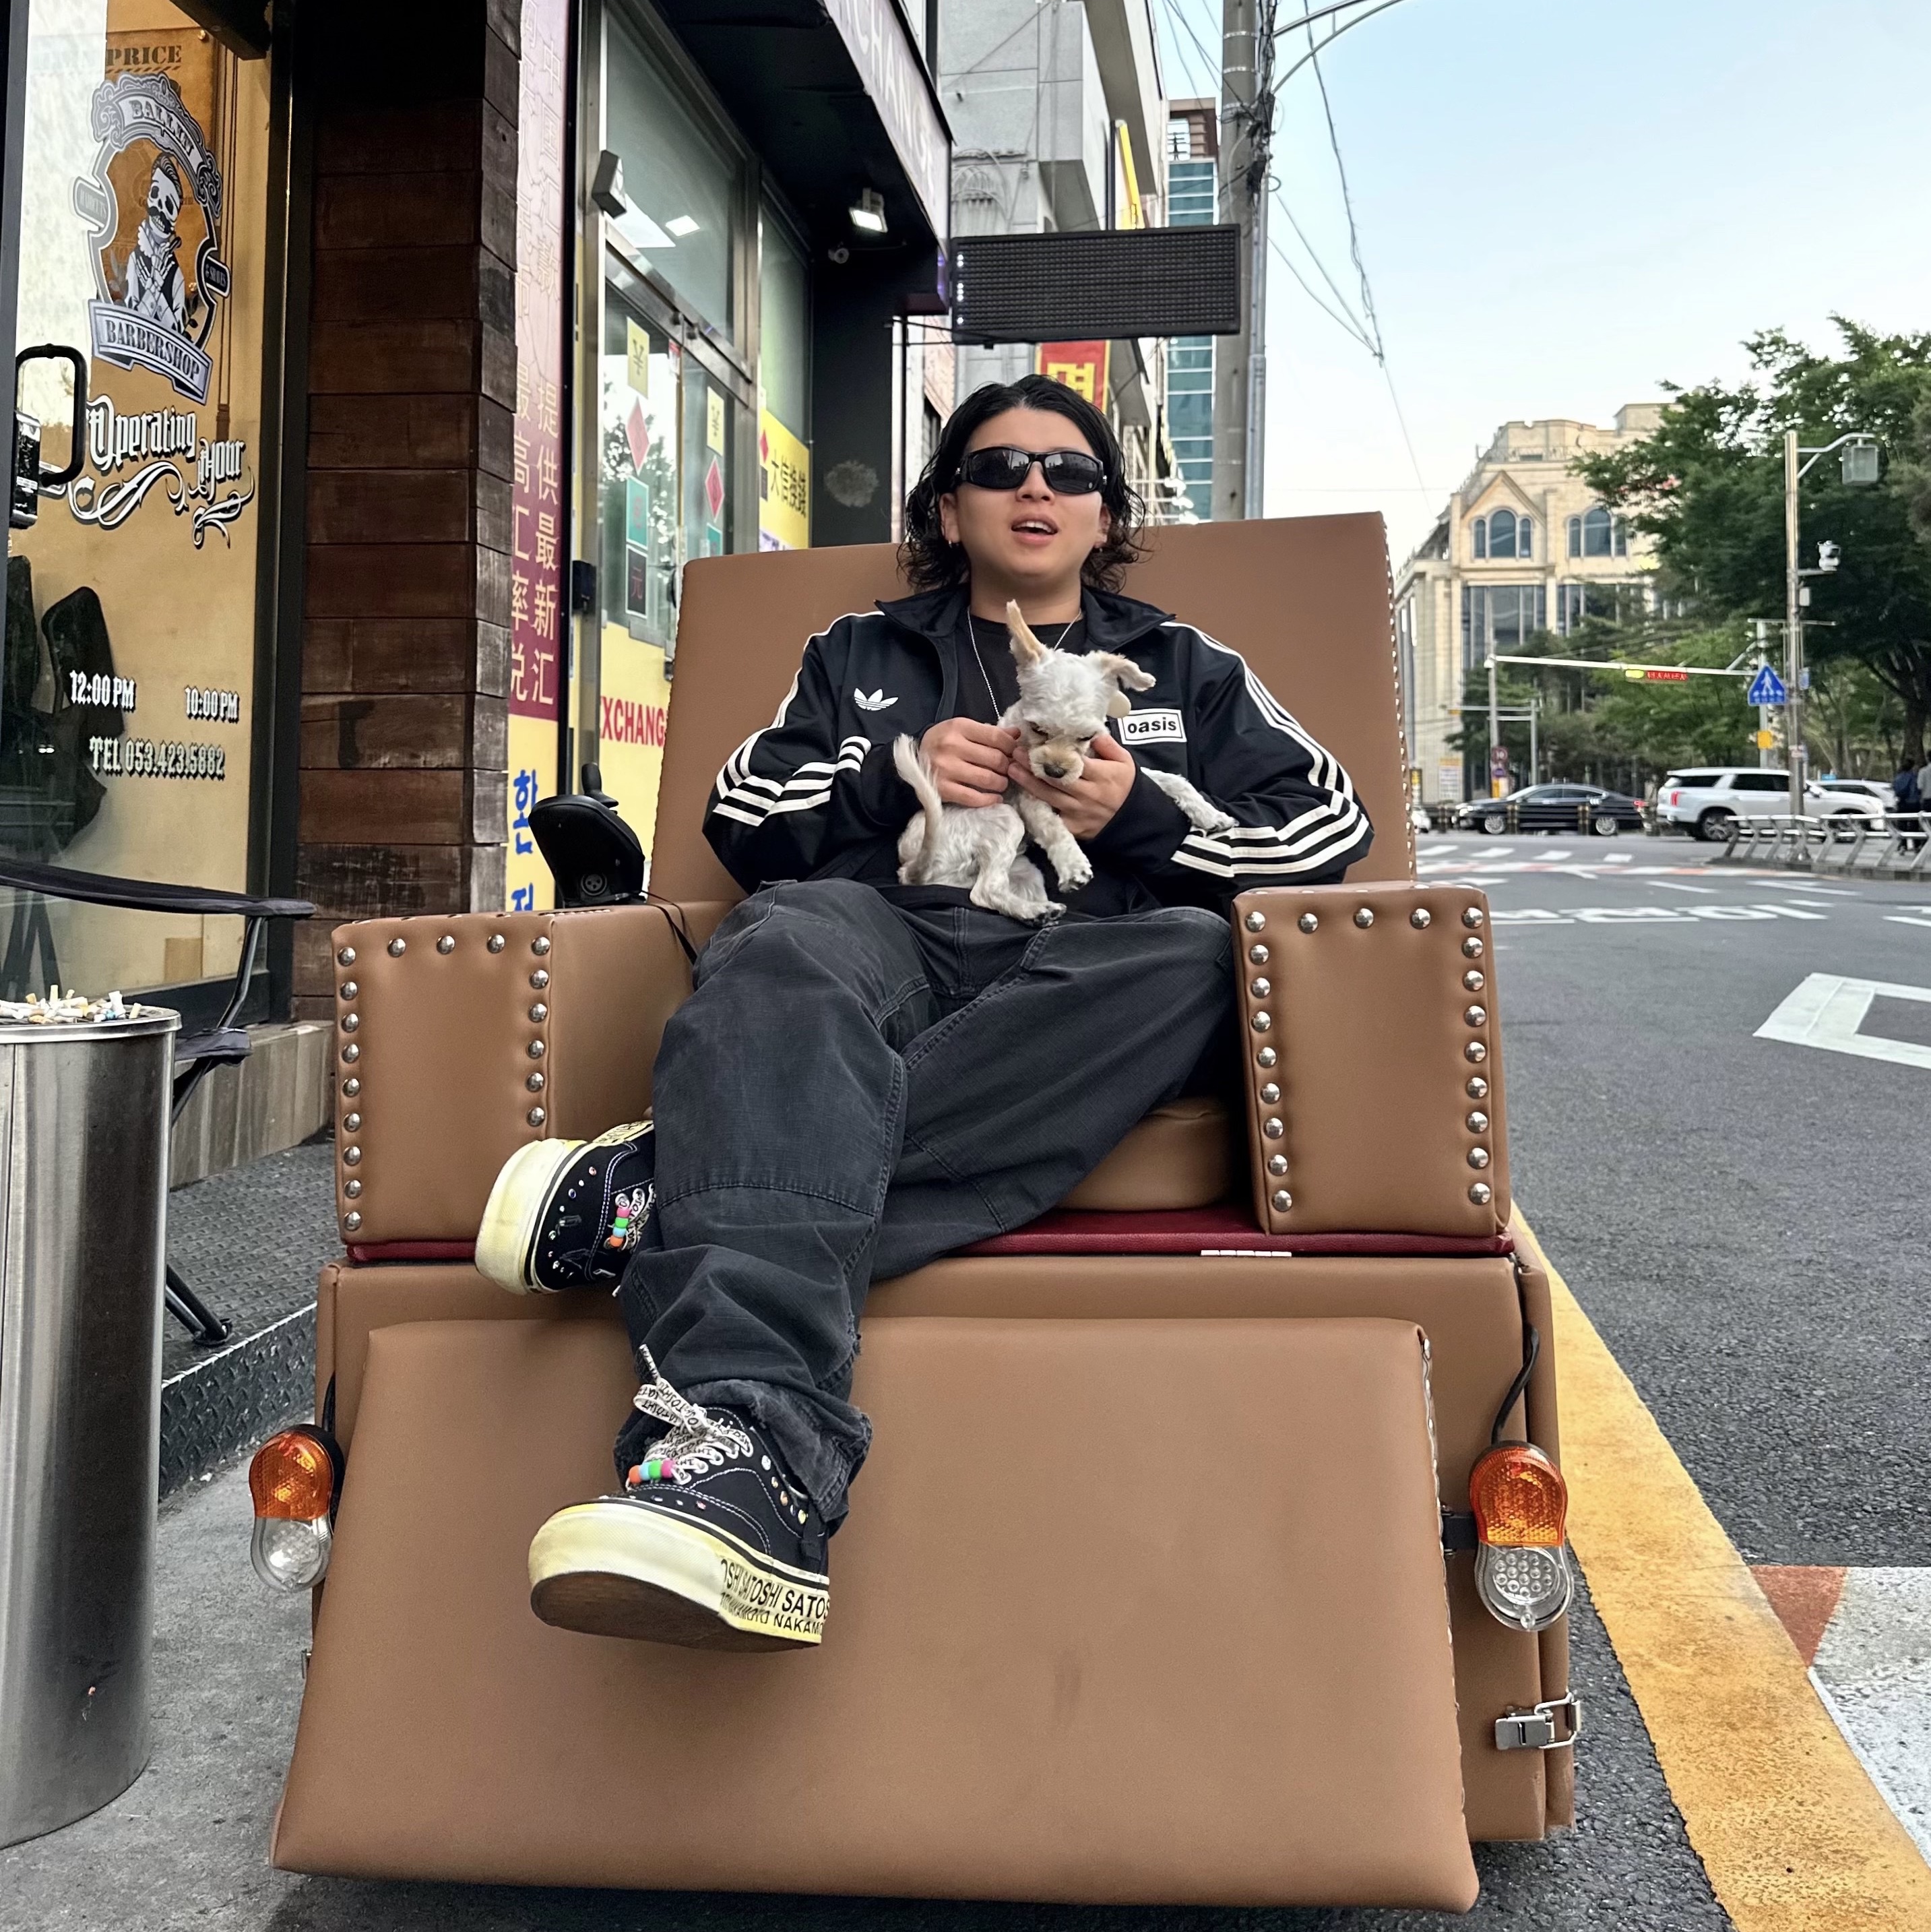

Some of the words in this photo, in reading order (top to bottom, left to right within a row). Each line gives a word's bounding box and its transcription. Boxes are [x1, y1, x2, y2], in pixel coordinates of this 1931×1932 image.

[106, 44, 182, 66] PRICE
[129, 99, 196, 156] BALLIN
[106, 319, 200, 381] BARBERSHOP
[86, 394, 197, 471] Operating
[187, 437, 246, 501] Hour
[69, 670, 112, 707] 12:00
[113, 675, 135, 712] PM
[185, 686, 218, 720] 10:00
[219, 690, 239, 722] PM
[599, 695, 666, 747] XCHANG
[1127, 717, 1177, 734] oasis
[89, 736, 123, 776] TEL
[125, 738, 226, 780] 053.423.5882
